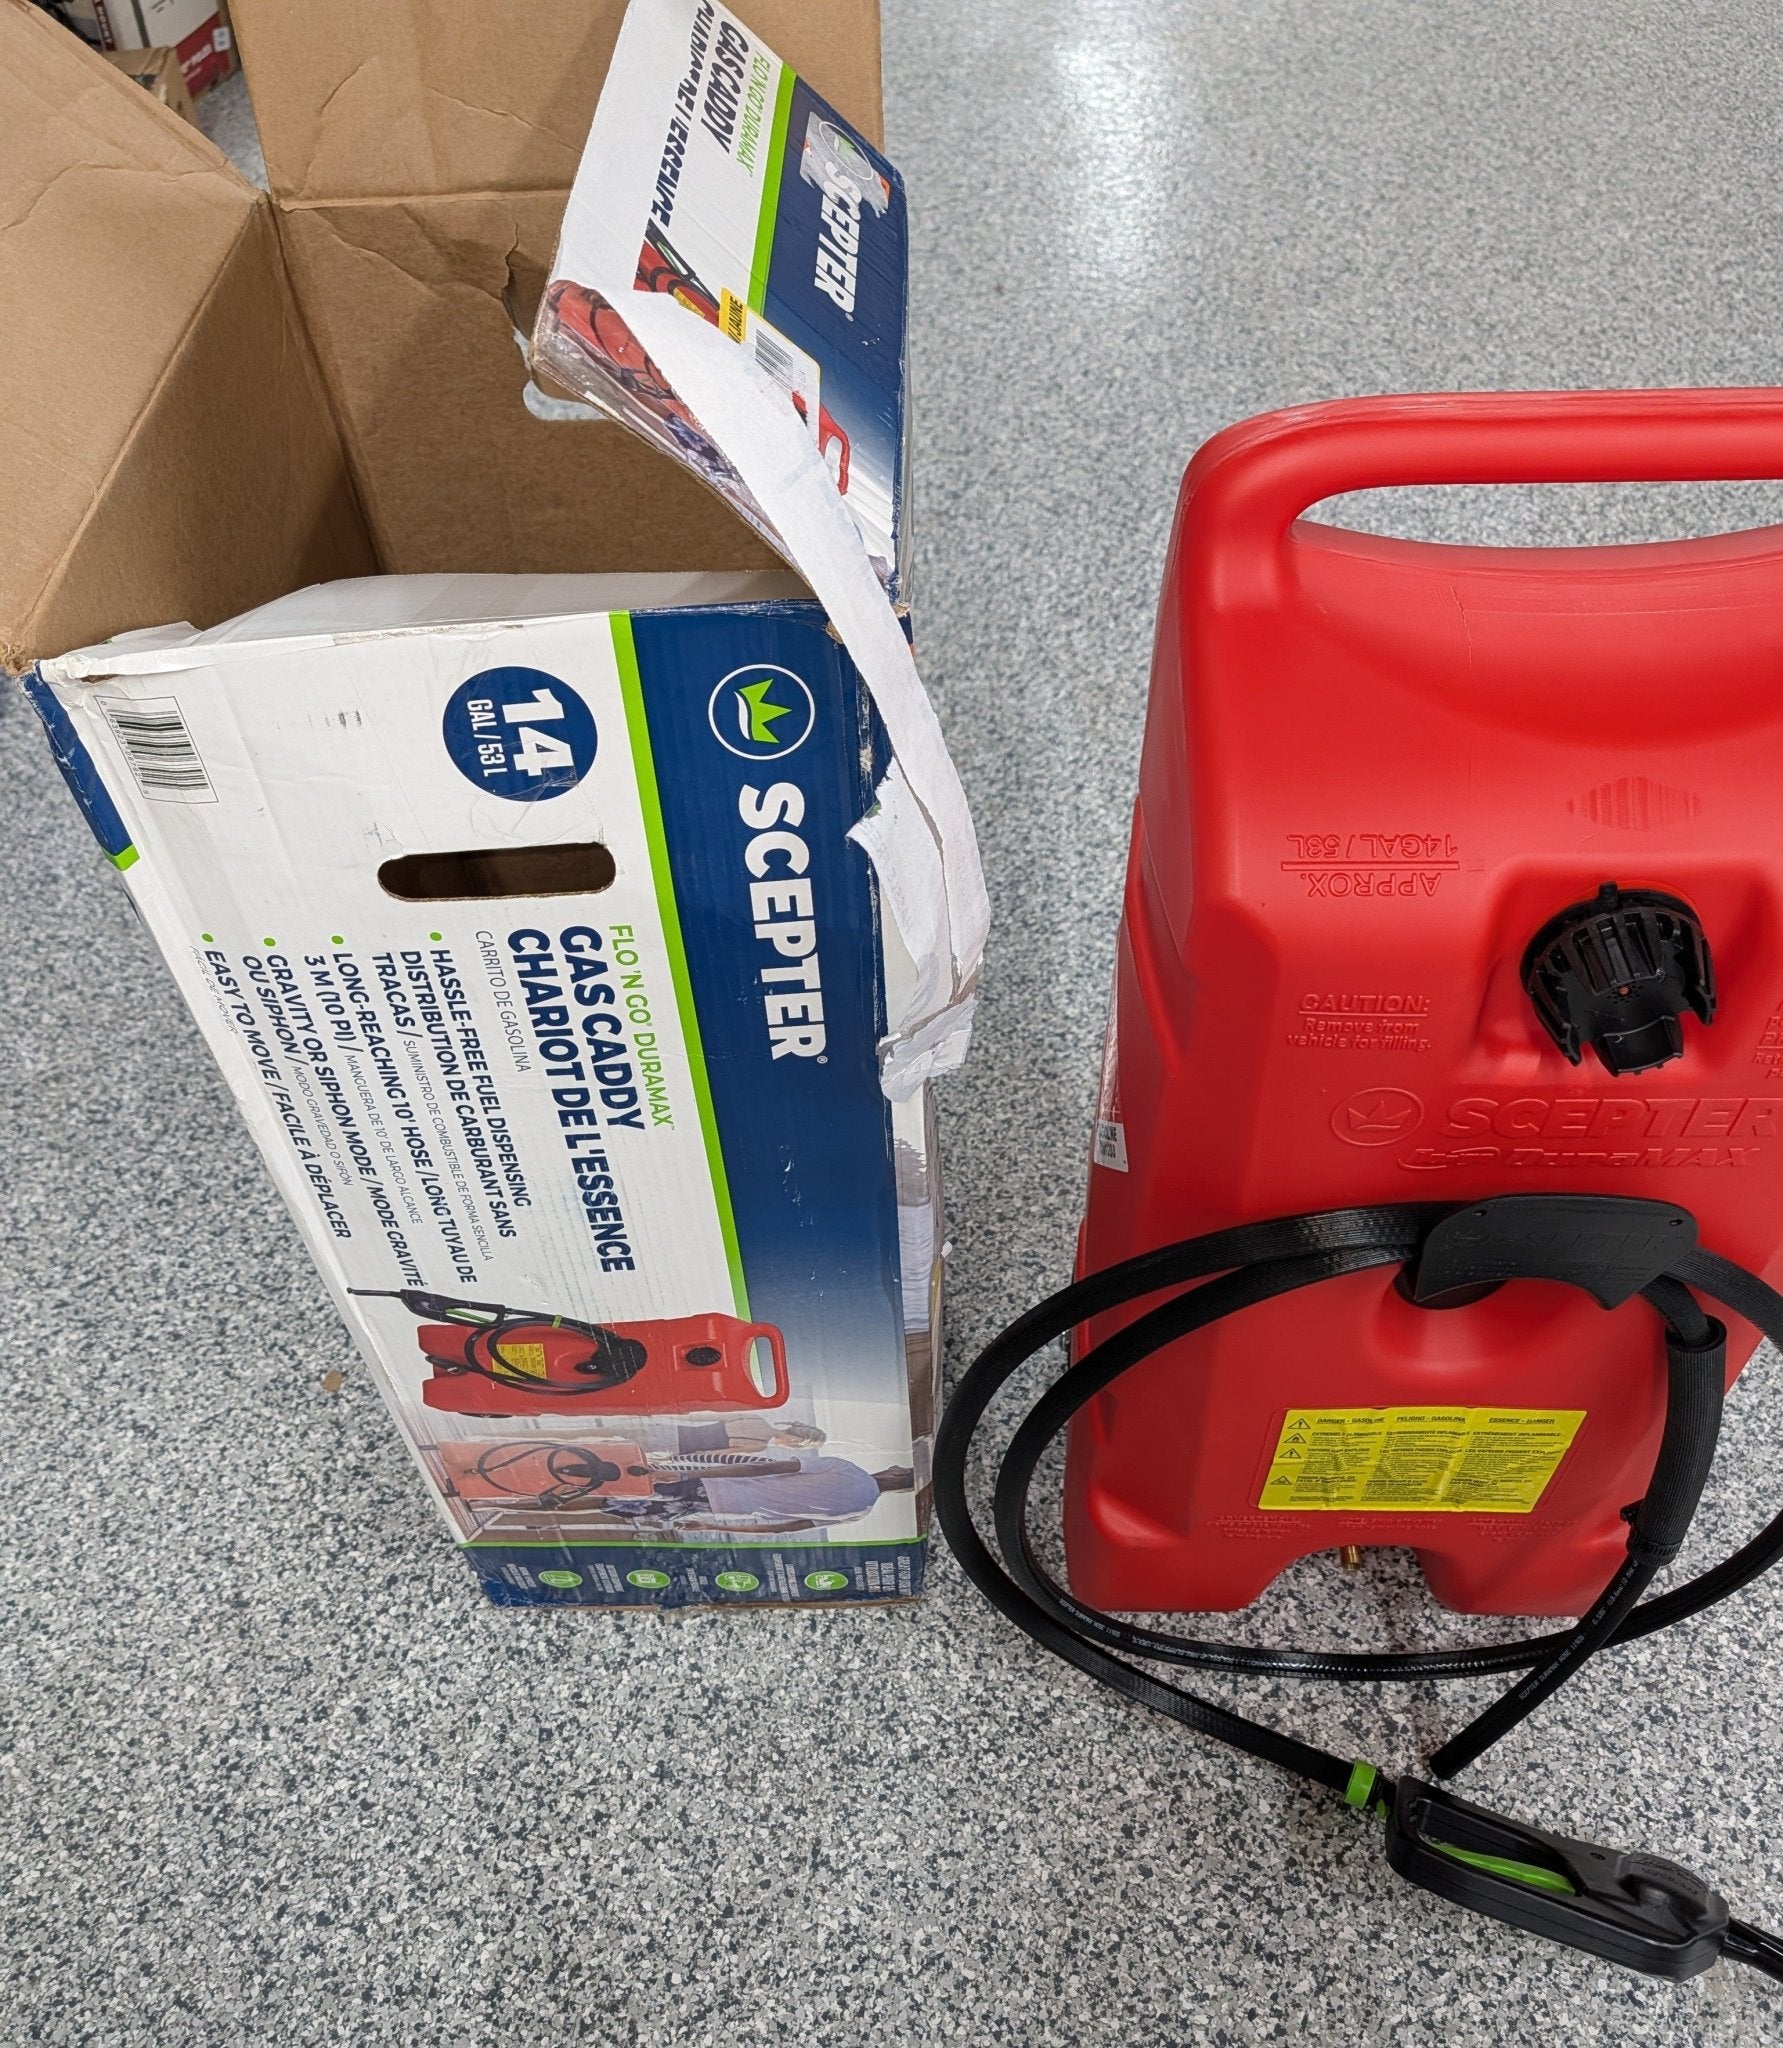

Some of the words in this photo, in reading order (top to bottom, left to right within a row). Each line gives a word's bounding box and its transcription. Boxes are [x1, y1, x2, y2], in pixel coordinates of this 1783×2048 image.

[701, 62, 741, 154] CADDY
[467, 699, 497, 731] GAL
[502, 688, 574, 776] 14
[1286, 833, 1342, 858] 53L
[1360, 833, 1459, 858] 14GAL
[1300, 872, 1442, 897] APPROX.
[304, 954, 326, 966] 3
[475, 930, 505, 988] CARRITO
[560, 926, 615, 1006] GAS
[609, 924, 639, 966] FLO
[204, 950, 244, 1000] EASY
[266, 954, 318, 1034] GRAVITY
[310, 970, 334, 987] M
[372, 952, 416, 1037] TRACAS
[231, 1003, 256, 1026] TO
[242, 955, 270, 984] OU
[256, 987, 302, 1061] SIPHON
[400, 949, 460, 1076] DISTRIBUTION
[430, 948, 488, 1073] HASSLE-FREE
[493, 989, 511, 1006] DE
[507, 928, 587, 1081] CHARIOT
[1300, 993, 1431, 1012] CAUTION:
[501, 1008, 531, 1073] GASOLINA
[1288, 1032, 1347, 1049] vehicle
[1351, 1034, 1378, 1049] for
[1304, 1017, 1373, 1033] Remove
[1379, 1018, 1420, 1034] from
[243, 1029, 283, 1081] MOVE
[302, 1037, 329, 1062] OR
[403, 1040, 435, 1101] SUMINISTRO
[581, 1013, 646, 1130] CADDY
[314, 1065, 356, 1128] SIPHON
[344, 1054, 376, 1111] MANGUERA
[446, 1079, 471, 1101] DE
[473, 1074, 502, 1115] FUEL
[271, 1091, 313, 1148] FACILE
[332, 952, 406, 1101] LONG-REACHING
[400, 1126, 434, 1168] HOSE
[421, 1178, 452, 1217] LONG
[438, 1218, 470, 1263] TUYAU
[456, 1266, 478, 1283] DE
[368, 1113, 383, 1126] DE
[425, 1102, 441, 1115] DE
[551, 1088, 598, 1128] DE
[1440, 1096, 1783, 1139] SCEPTER
[342, 1130, 377, 1176] MODE
[385, 1155, 407, 1185] LARGO
[432, 1116, 464, 1180] COMBUSTIBLE
[456, 1103, 505, 1198] CARBURANT
[487, 1117, 532, 1208] DISPENSING
[304, 1163, 352, 1239] DÉPLACER
[366, 1186, 400, 1229] MODE
[397, 1186, 423, 1224] ALCANCE
[455, 1179, 470, 1193] DE
[564, 1133, 636, 1273] L'ESSENCE
[460, 1194, 480, 1224] FORMA
[489, 1199, 516, 1238] SANS
[386, 1230, 429, 1287] GRAVITÉ
[472, 1223, 494, 1261] SENCILLA
